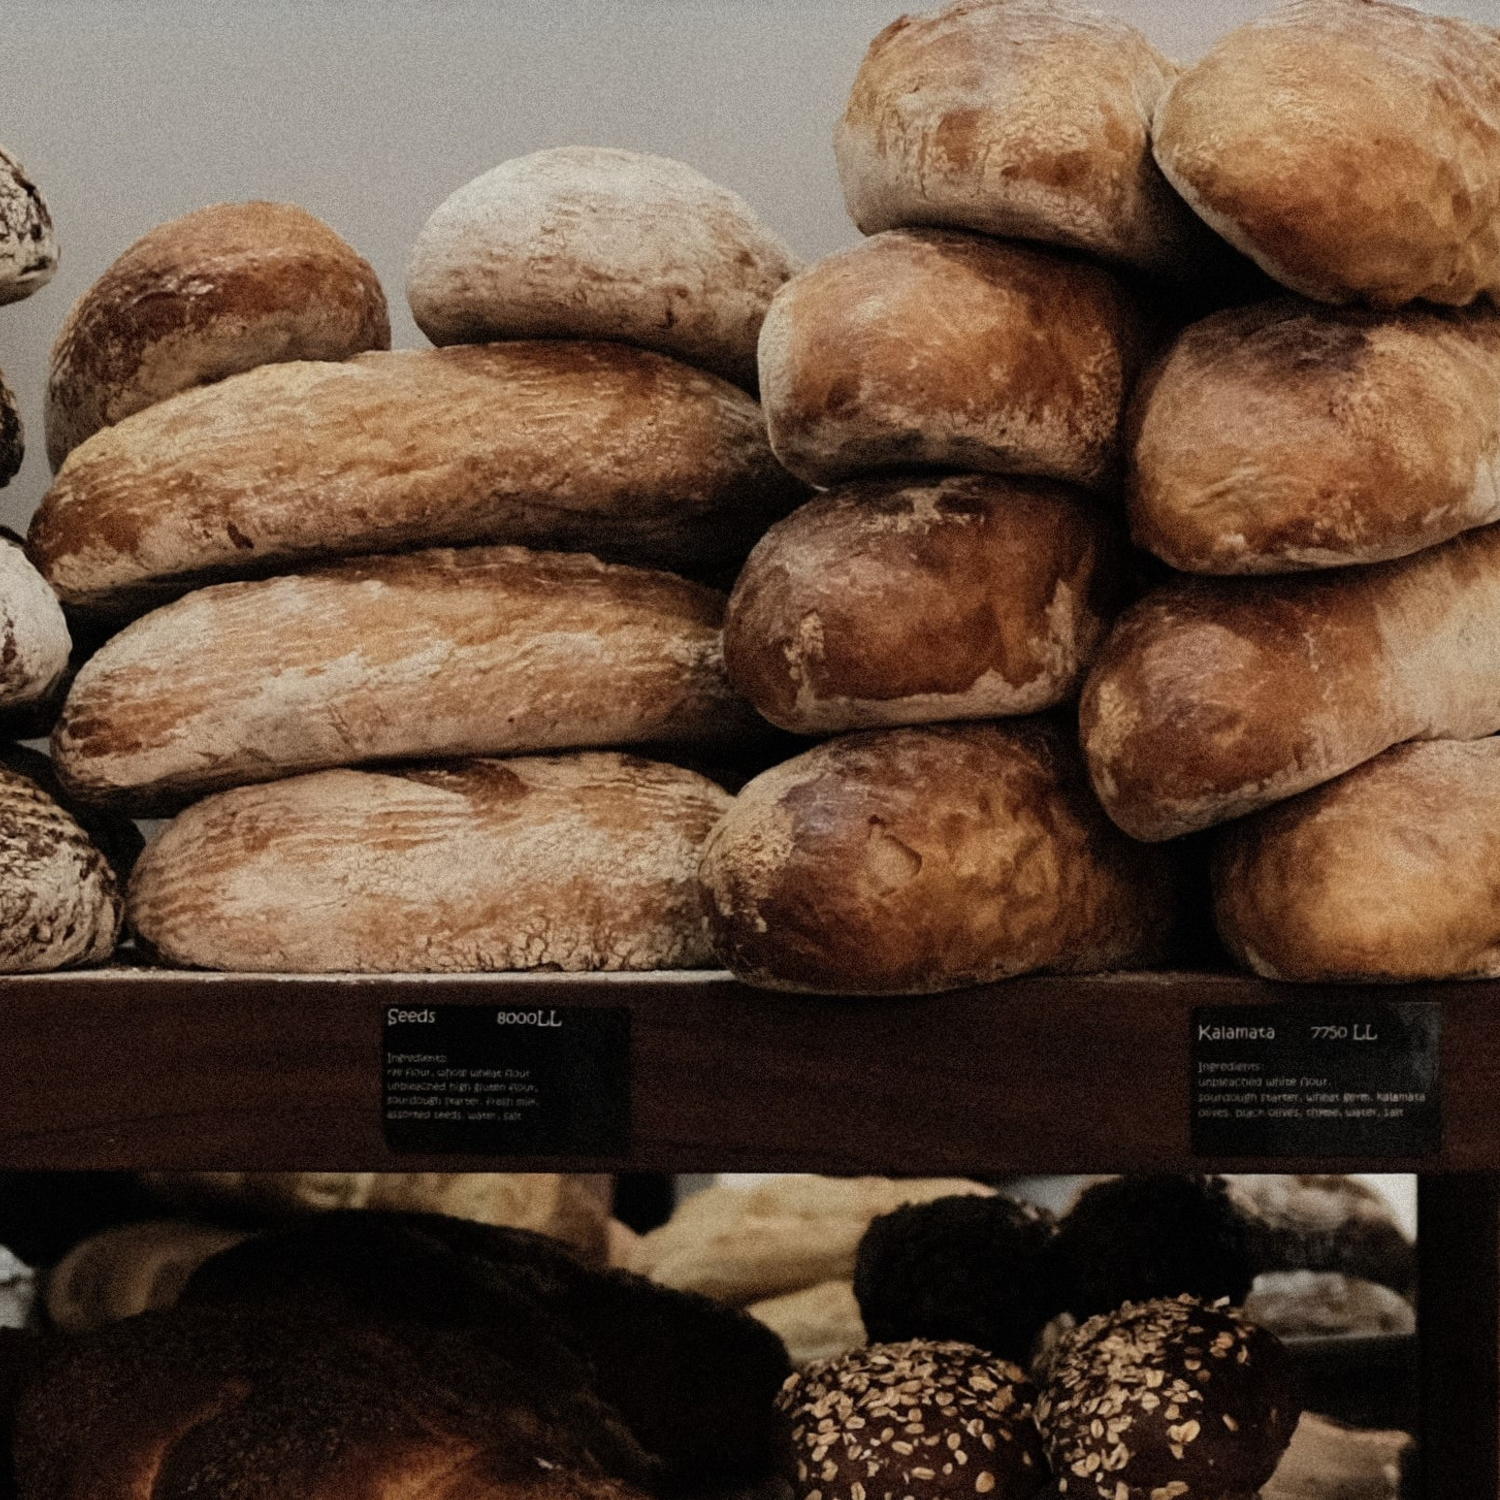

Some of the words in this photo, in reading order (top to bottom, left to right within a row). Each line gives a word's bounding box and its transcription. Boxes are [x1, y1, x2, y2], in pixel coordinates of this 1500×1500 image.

[388, 1008, 437, 1027] Seeds
[1197, 1024, 1275, 1042] Kalamata
[1310, 1026, 1347, 1041] 7750
[1352, 1023, 1379, 1041] LL
